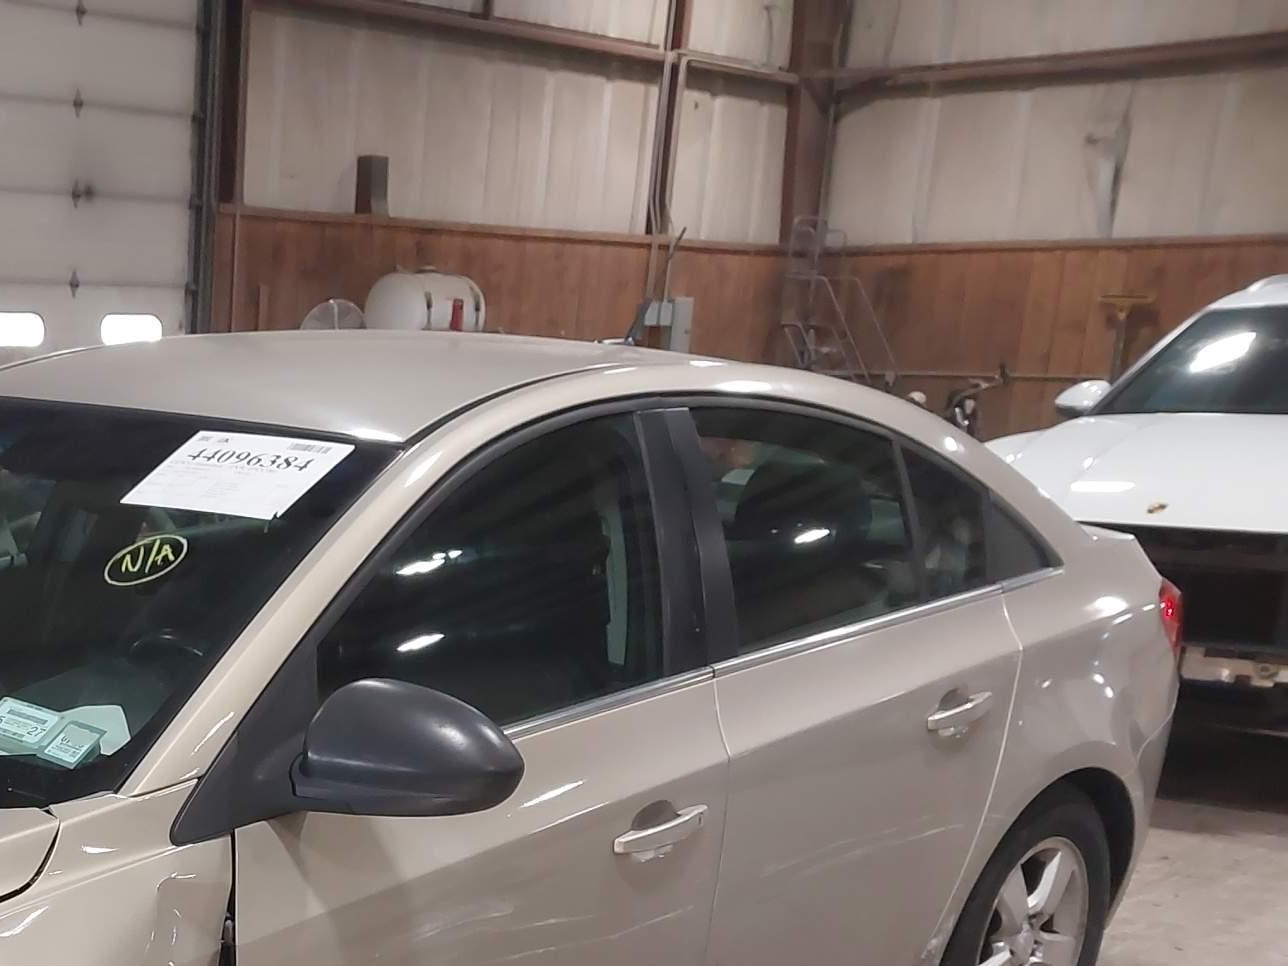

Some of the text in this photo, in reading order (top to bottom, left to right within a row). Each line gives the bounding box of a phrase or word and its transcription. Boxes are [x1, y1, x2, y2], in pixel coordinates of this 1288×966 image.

[187, 447, 315, 472] 44096384
[120, 539, 176, 574] N/A
[26, 726, 47, 738] 27
